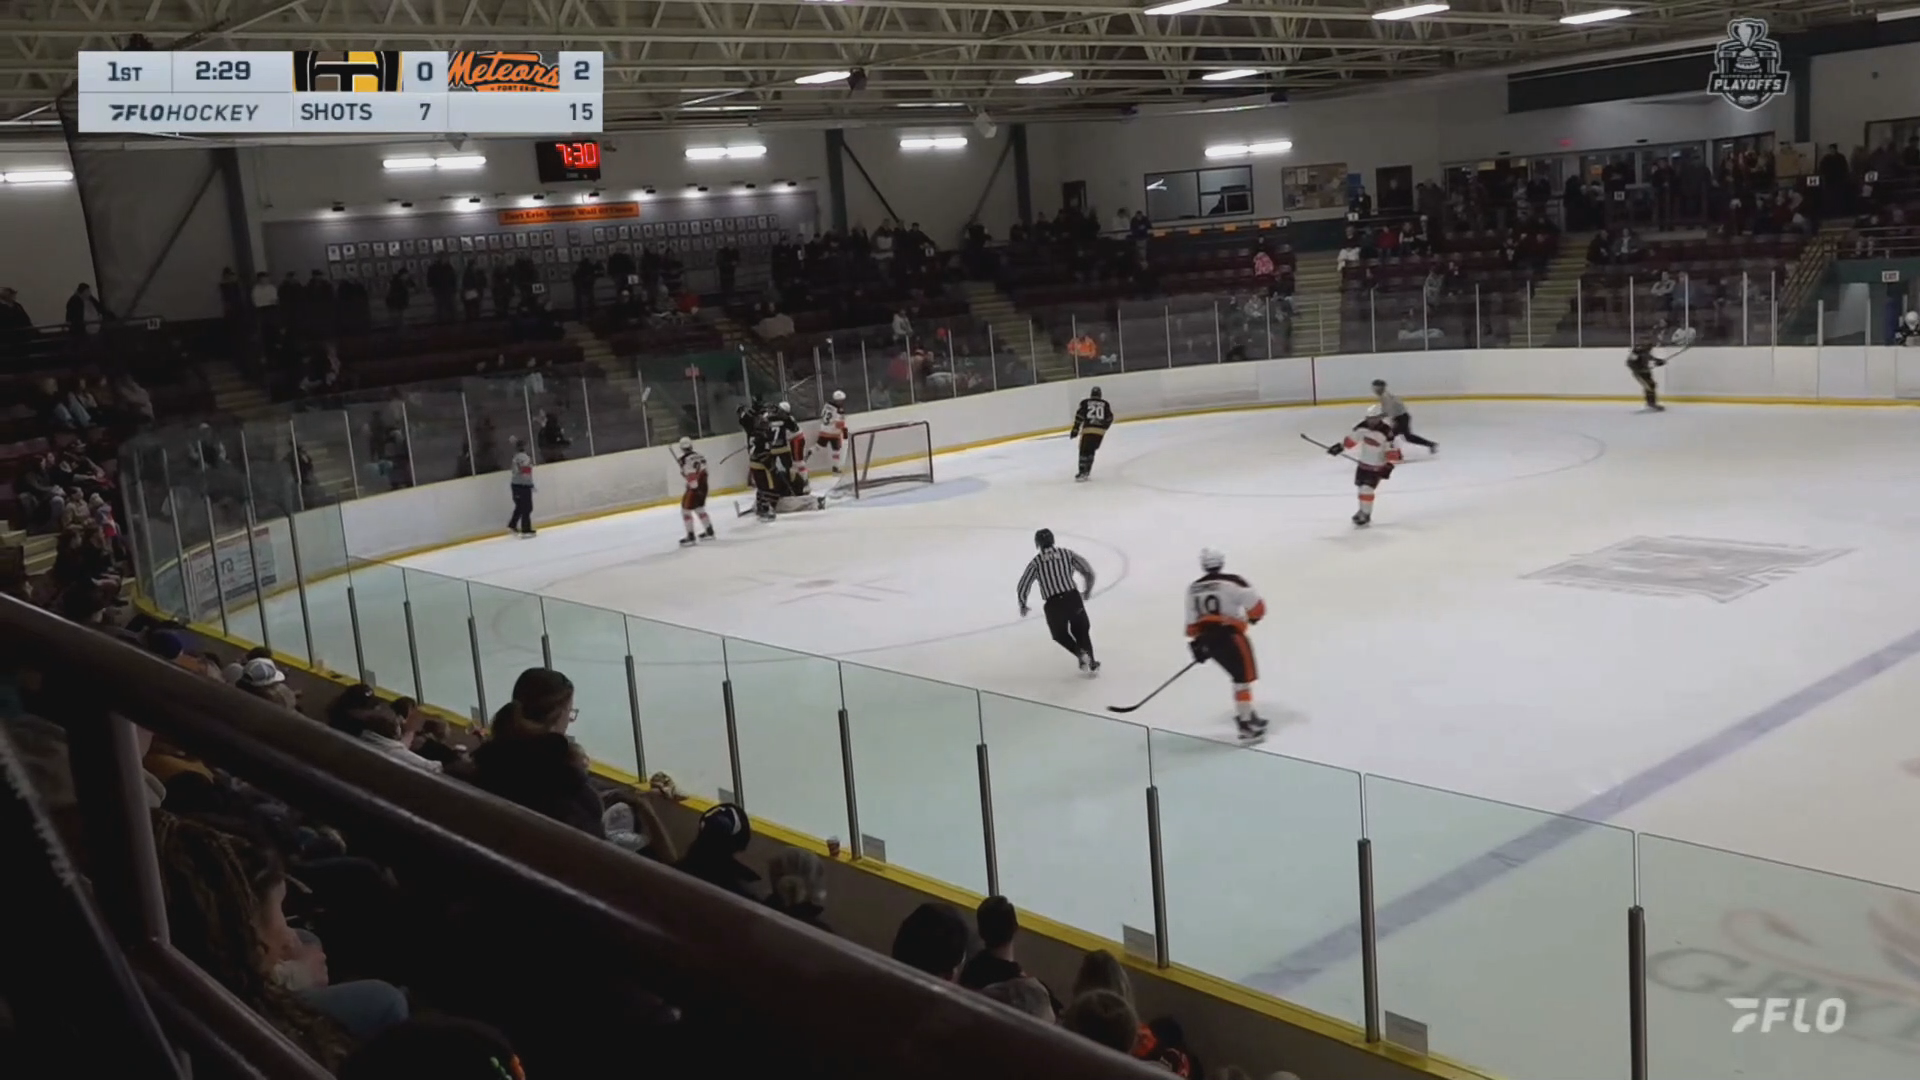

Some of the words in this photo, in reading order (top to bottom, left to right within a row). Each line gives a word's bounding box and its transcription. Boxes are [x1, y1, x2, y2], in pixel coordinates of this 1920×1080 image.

[555, 142, 597, 165] 7:30
[1087, 405, 1105, 420] 20
[771, 426, 780, 444] 7
[1194, 594, 1220, 615] 10
